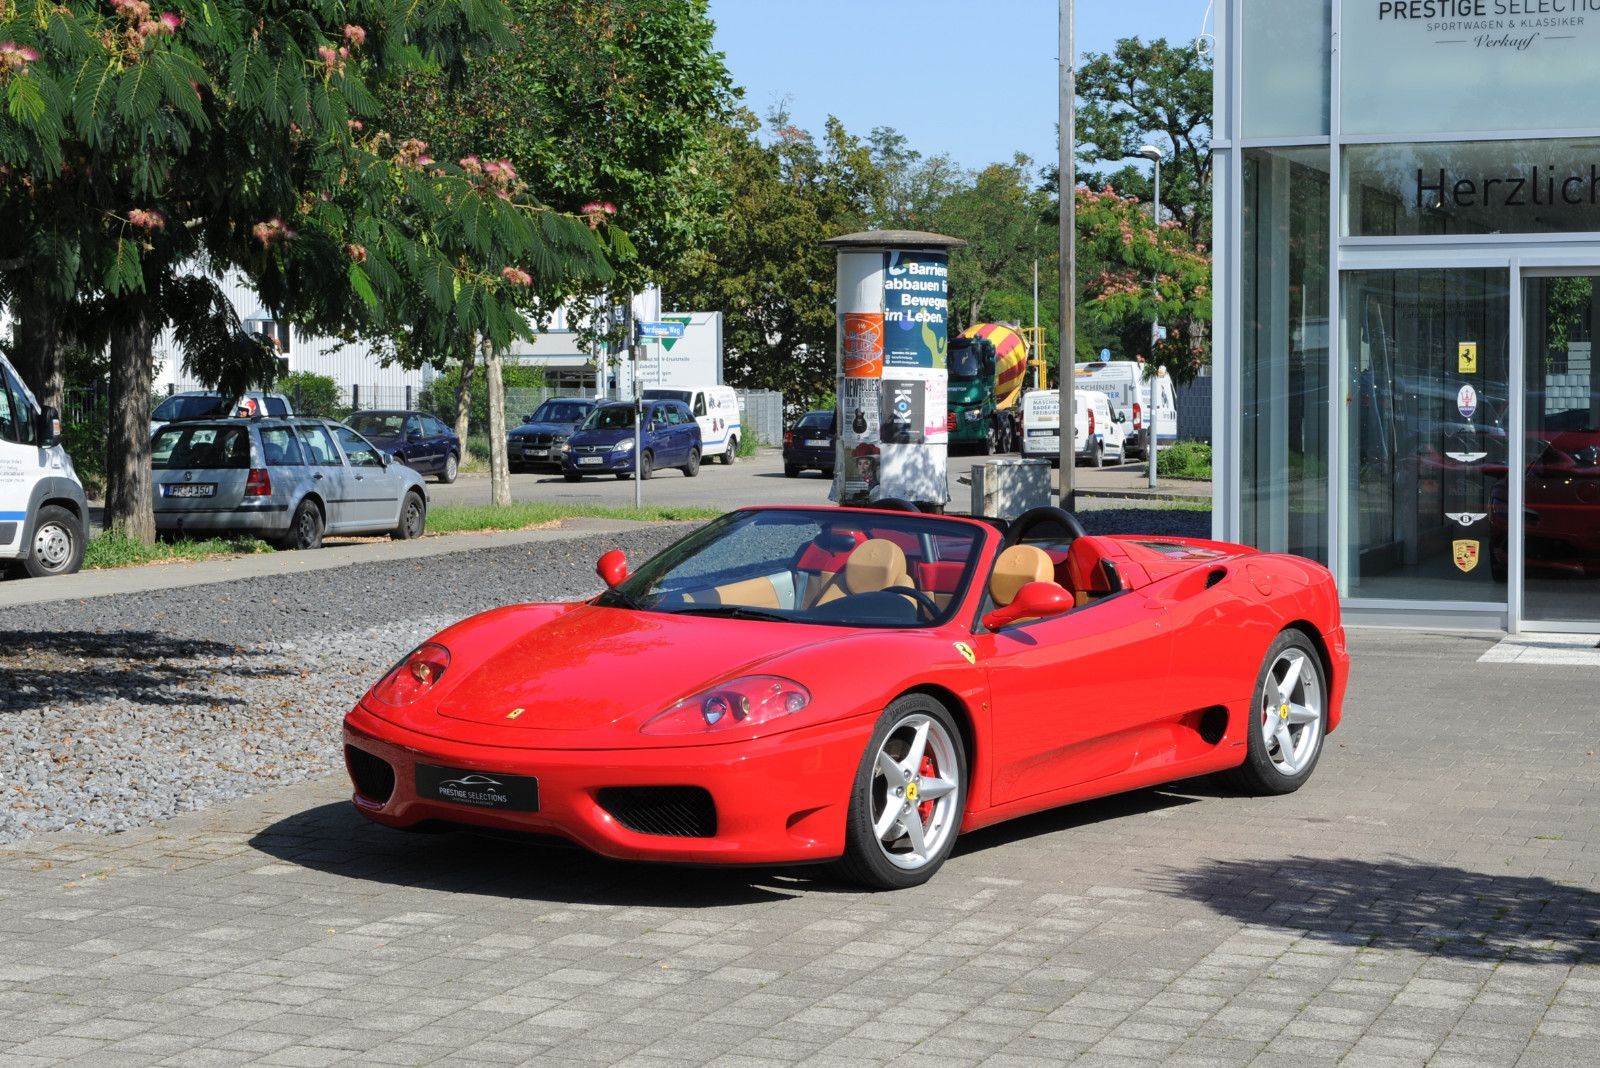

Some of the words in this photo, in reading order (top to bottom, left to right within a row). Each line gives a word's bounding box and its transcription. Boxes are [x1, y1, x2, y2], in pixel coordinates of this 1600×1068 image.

[1379, 0, 1486, 20] PRESTIGE
[1426, 20, 1504, 32] SPORTWAGEN
[1508, 19, 1516, 29] &
[1520, 16, 1585, 28] KLASSIKER
[1474, 32, 1540, 51] Verkauf
[885, 278, 940, 292] abbauen
[885, 308, 903, 321] im
[907, 310, 943, 323] Leben.
[1075, 384, 1116, 392] ASCHINEN
[439, 787, 467, 798] PRESTIGE
[468, 792, 507, 802] SELECTIONS
